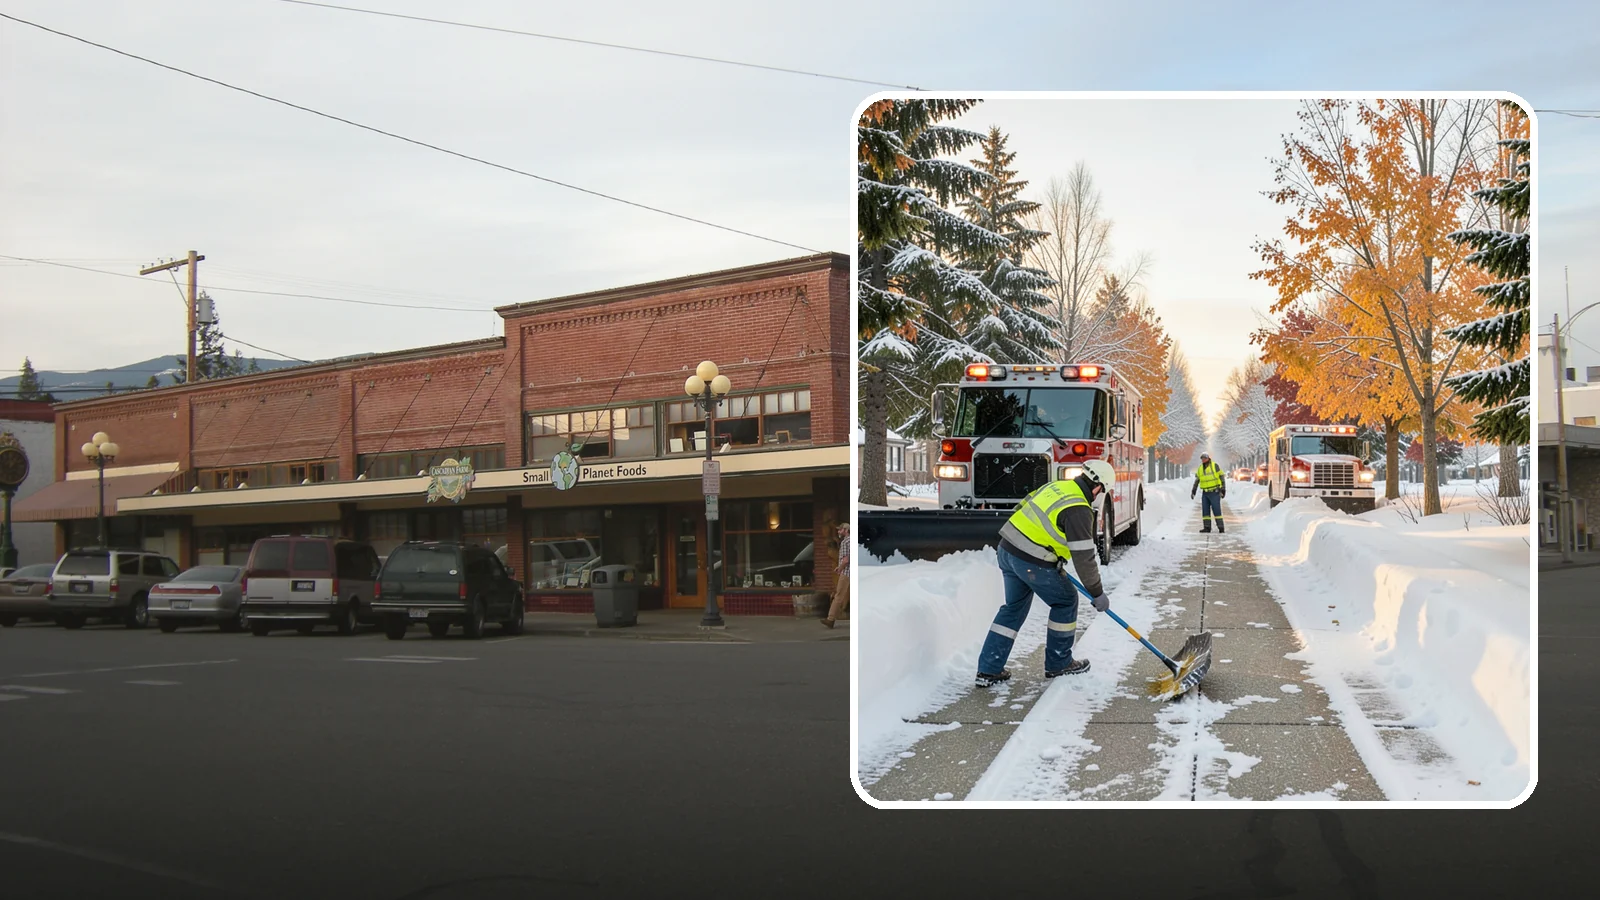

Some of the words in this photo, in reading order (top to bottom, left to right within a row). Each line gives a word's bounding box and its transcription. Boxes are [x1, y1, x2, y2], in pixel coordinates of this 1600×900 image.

[522, 471, 549, 483] Small
[582, 467, 614, 479] Planet
[616, 464, 647, 477] Foods
